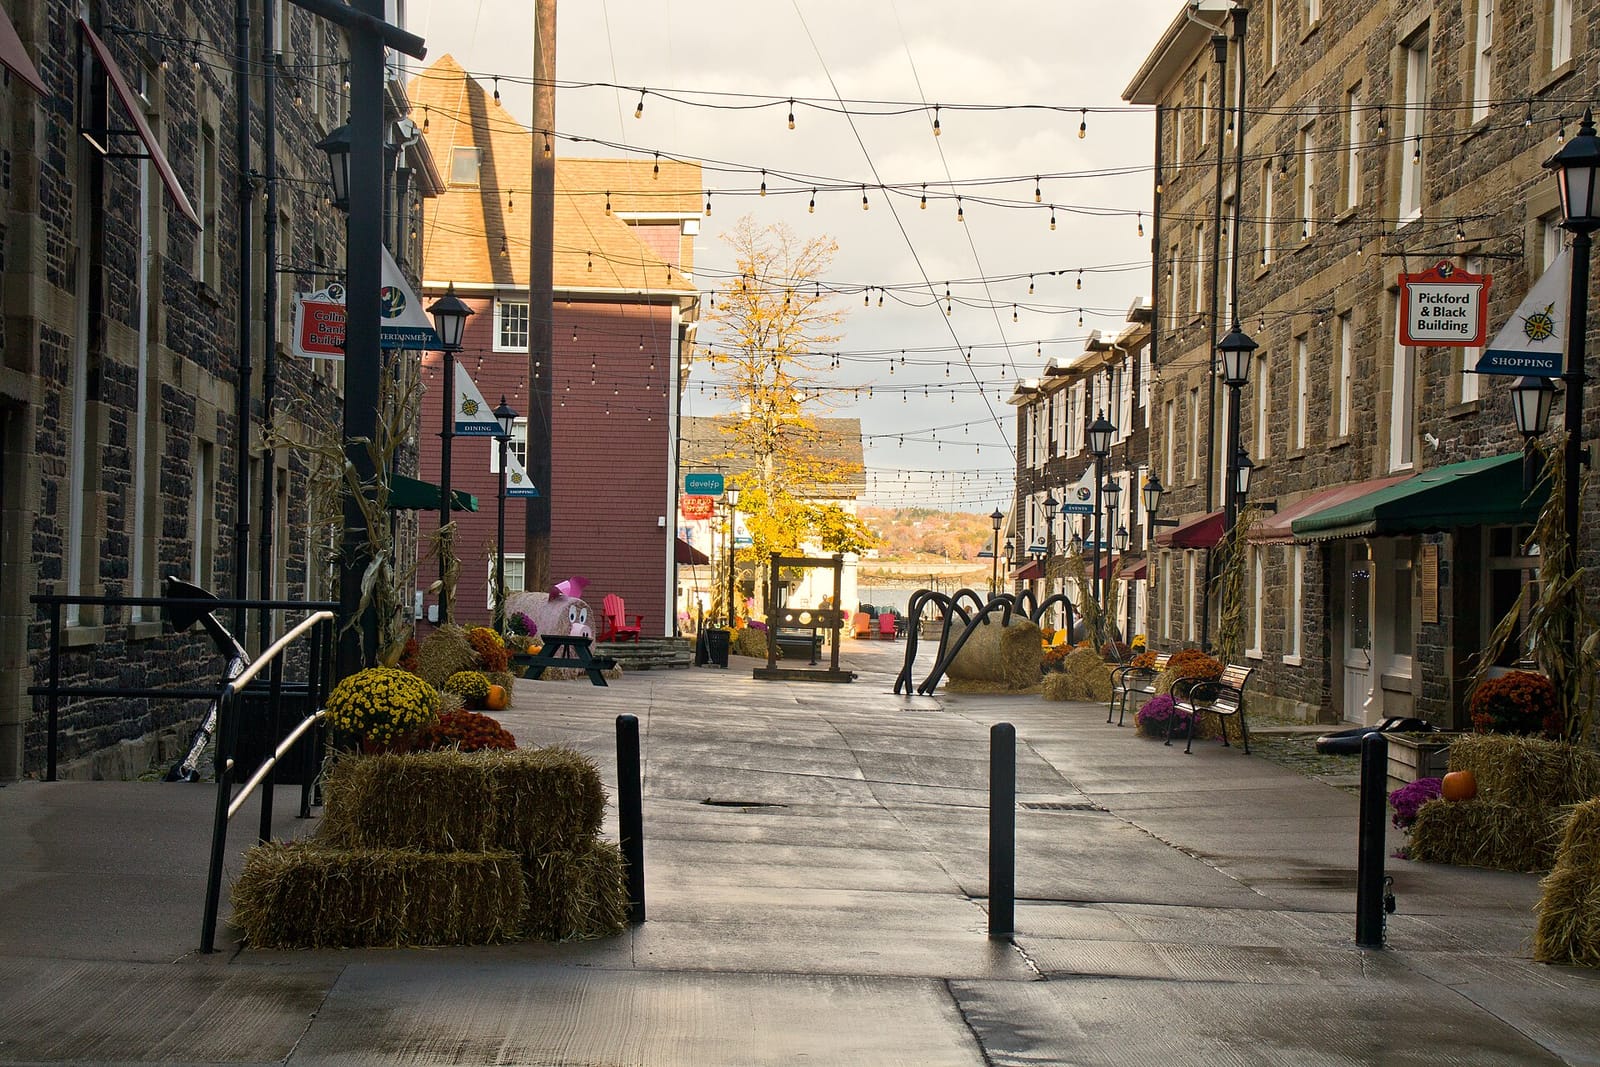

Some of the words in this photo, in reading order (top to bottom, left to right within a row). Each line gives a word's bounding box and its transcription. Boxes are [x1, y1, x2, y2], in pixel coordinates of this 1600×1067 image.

[1418, 292, 1470, 304] Pickford
[314, 310, 345, 322] Collin
[1420, 307, 1430, 317] &
[1433, 306, 1466, 318] Black
[318, 323, 345, 334] Bank
[1417, 320, 1469, 334] Building
[310, 333, 345, 346] Buildi
[380, 333, 433, 342] TERTAINMENT
[1491, 356, 1553, 368] SHOPPING
[464, 424, 492, 432] DINING
